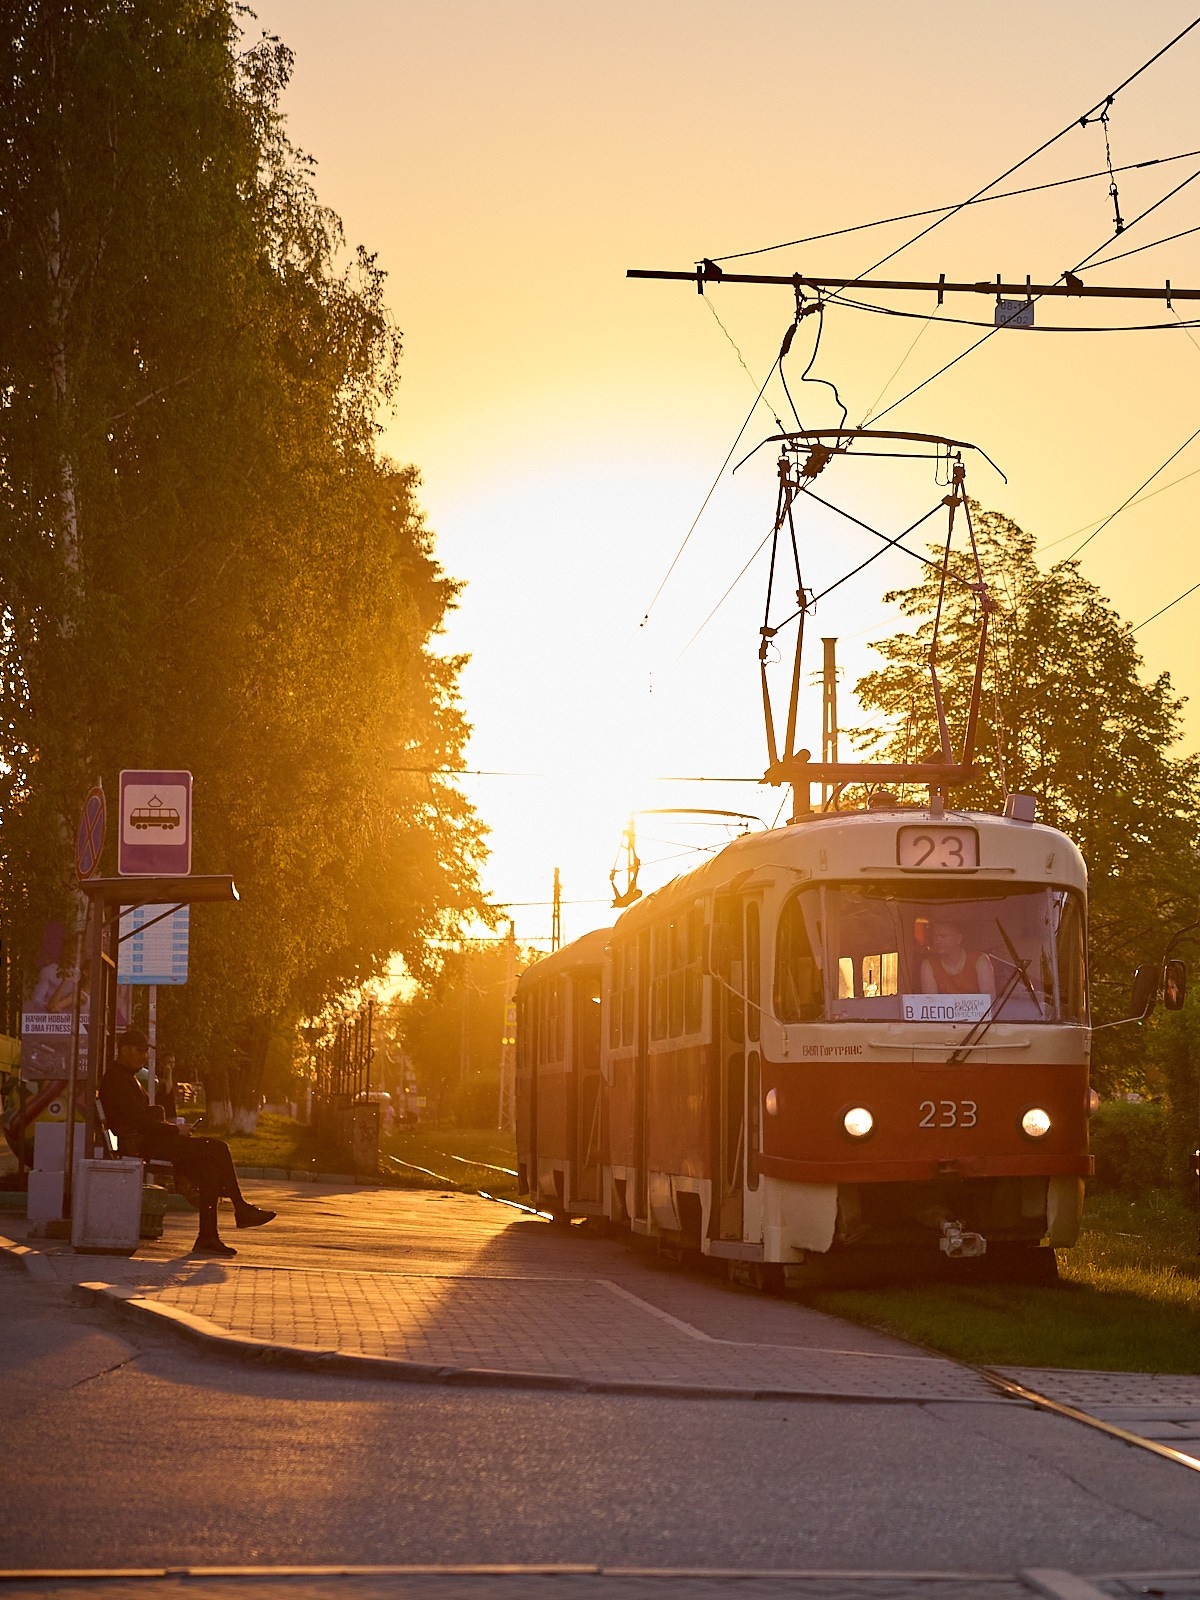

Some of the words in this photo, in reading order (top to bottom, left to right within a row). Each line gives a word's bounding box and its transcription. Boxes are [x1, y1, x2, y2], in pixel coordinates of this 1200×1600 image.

[913, 836, 963, 867] 23
[25, 1015, 47, 1023] НАЧНИ
[48, 1014, 71, 1023] НОВЫЙ
[905, 1006, 914, 1019] В
[921, 1006, 955, 1020] ДЕПО
[25, 1024, 30, 1032] В
[46, 1024, 71, 1032] FITNESS
[919, 1100, 977, 1127] 233
